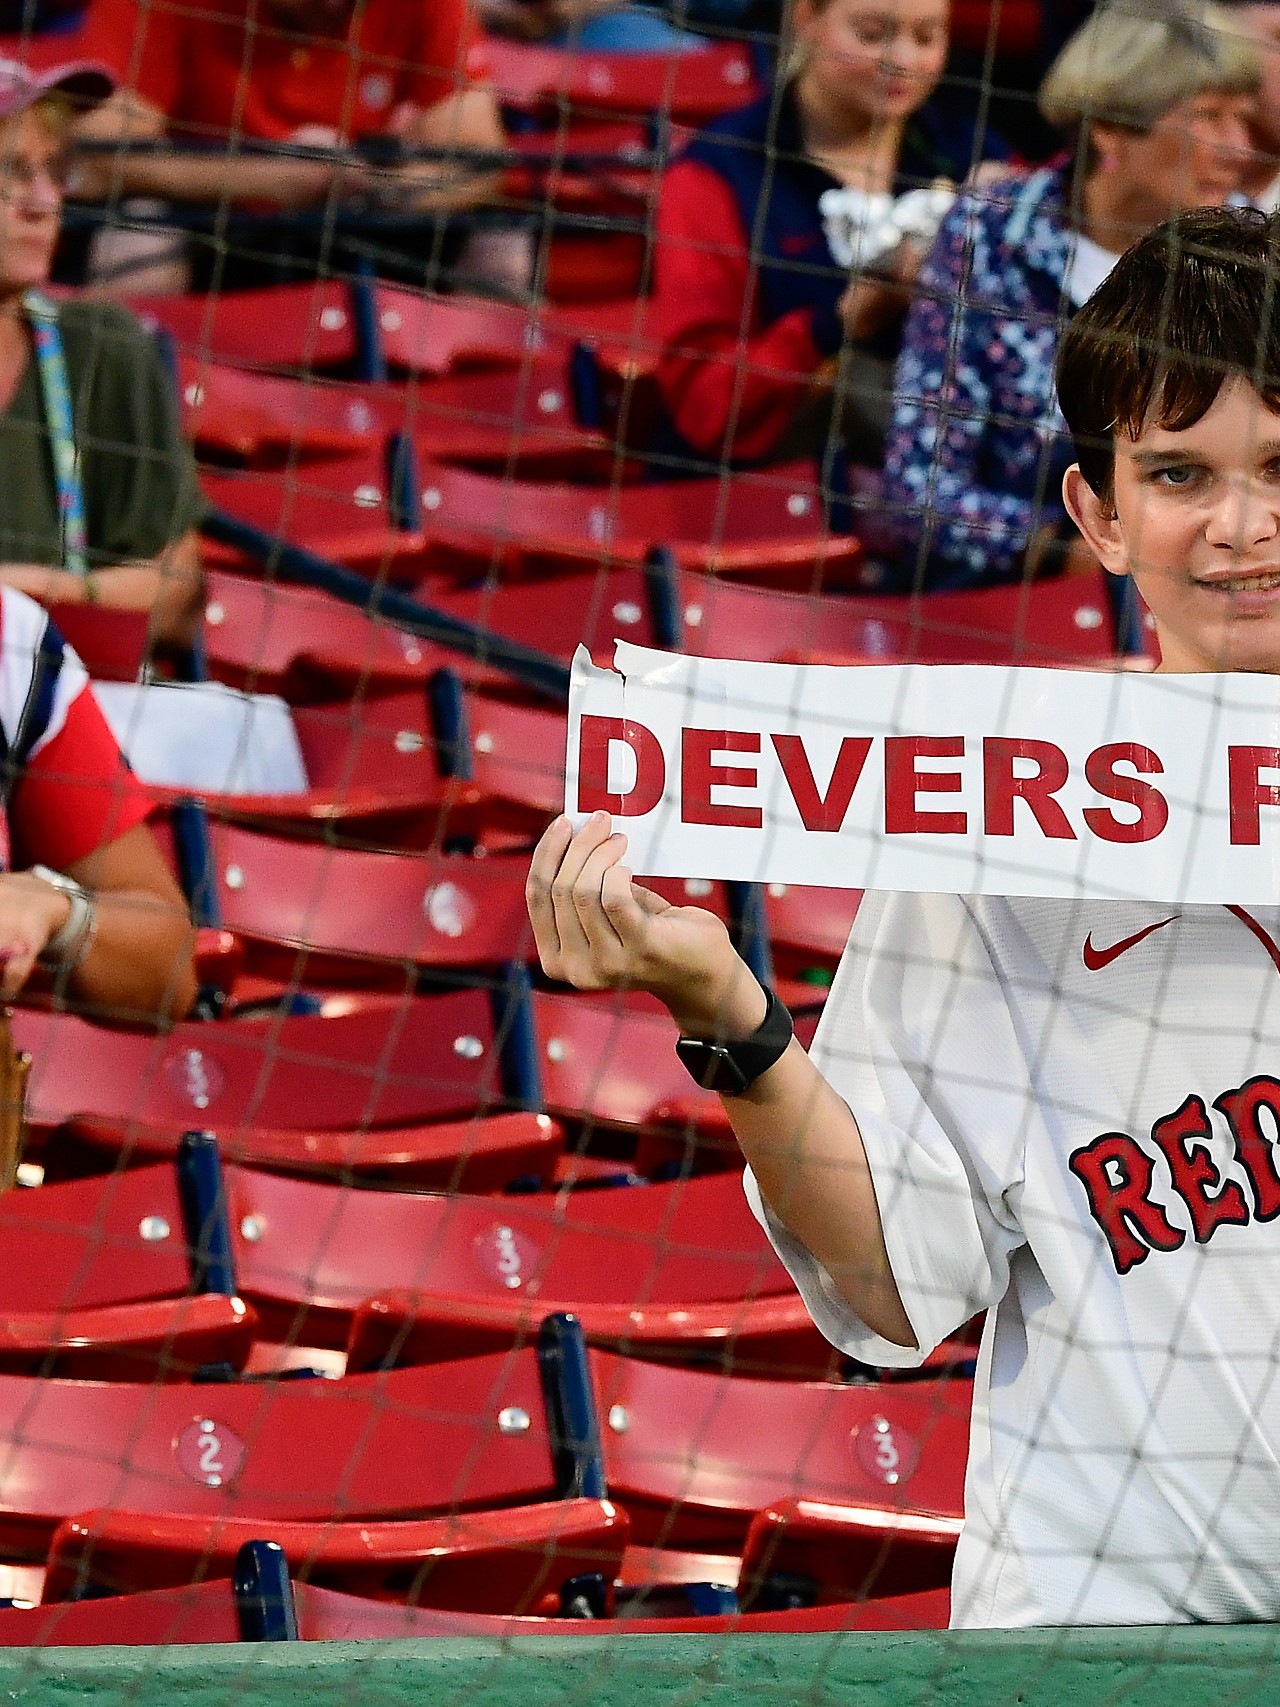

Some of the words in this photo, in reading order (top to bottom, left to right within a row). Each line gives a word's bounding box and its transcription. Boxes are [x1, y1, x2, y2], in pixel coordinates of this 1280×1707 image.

[577, 714, 1170, 845] DEVERS
[198, 1434, 222, 1472] 2
[874, 1433, 899, 1469] 3
